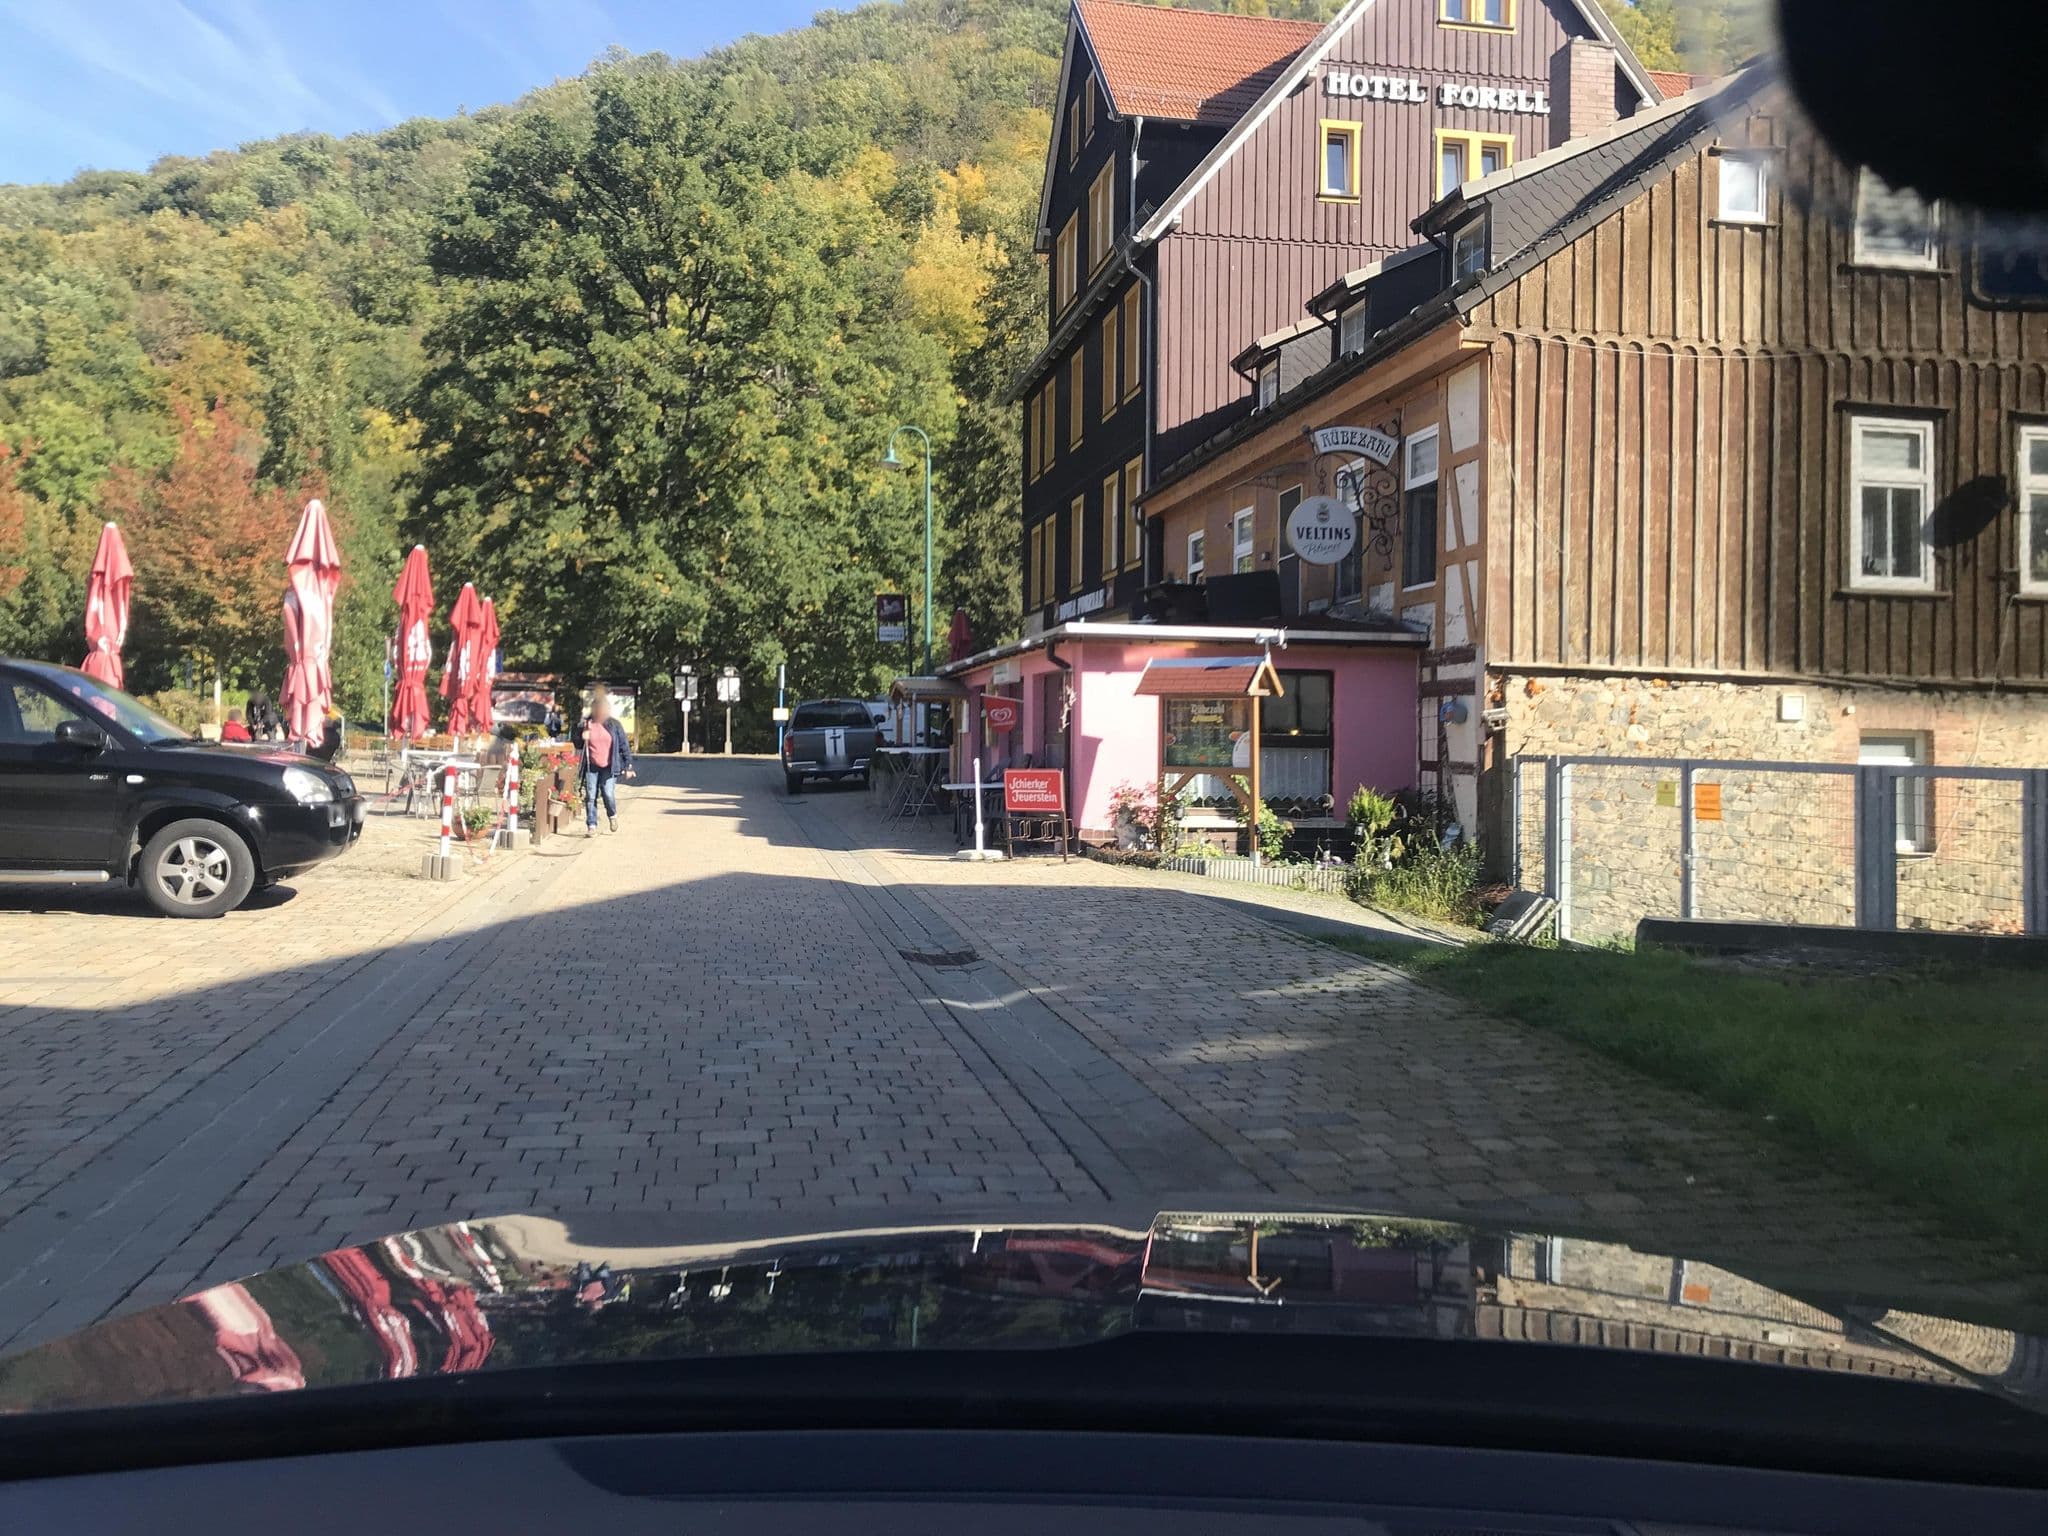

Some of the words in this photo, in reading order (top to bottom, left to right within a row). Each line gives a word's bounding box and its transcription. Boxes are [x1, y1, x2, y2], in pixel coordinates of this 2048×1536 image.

[1327, 71, 1426, 103] HOTEL
[1440, 83, 1550, 113] FORELL
[1320, 429, 1392, 458] RÜBEZAHL
[1296, 526, 1351, 540] VELTINS
[1009, 777, 1049, 790] Schierker
[1011, 790, 1058, 803] Feuerstein
